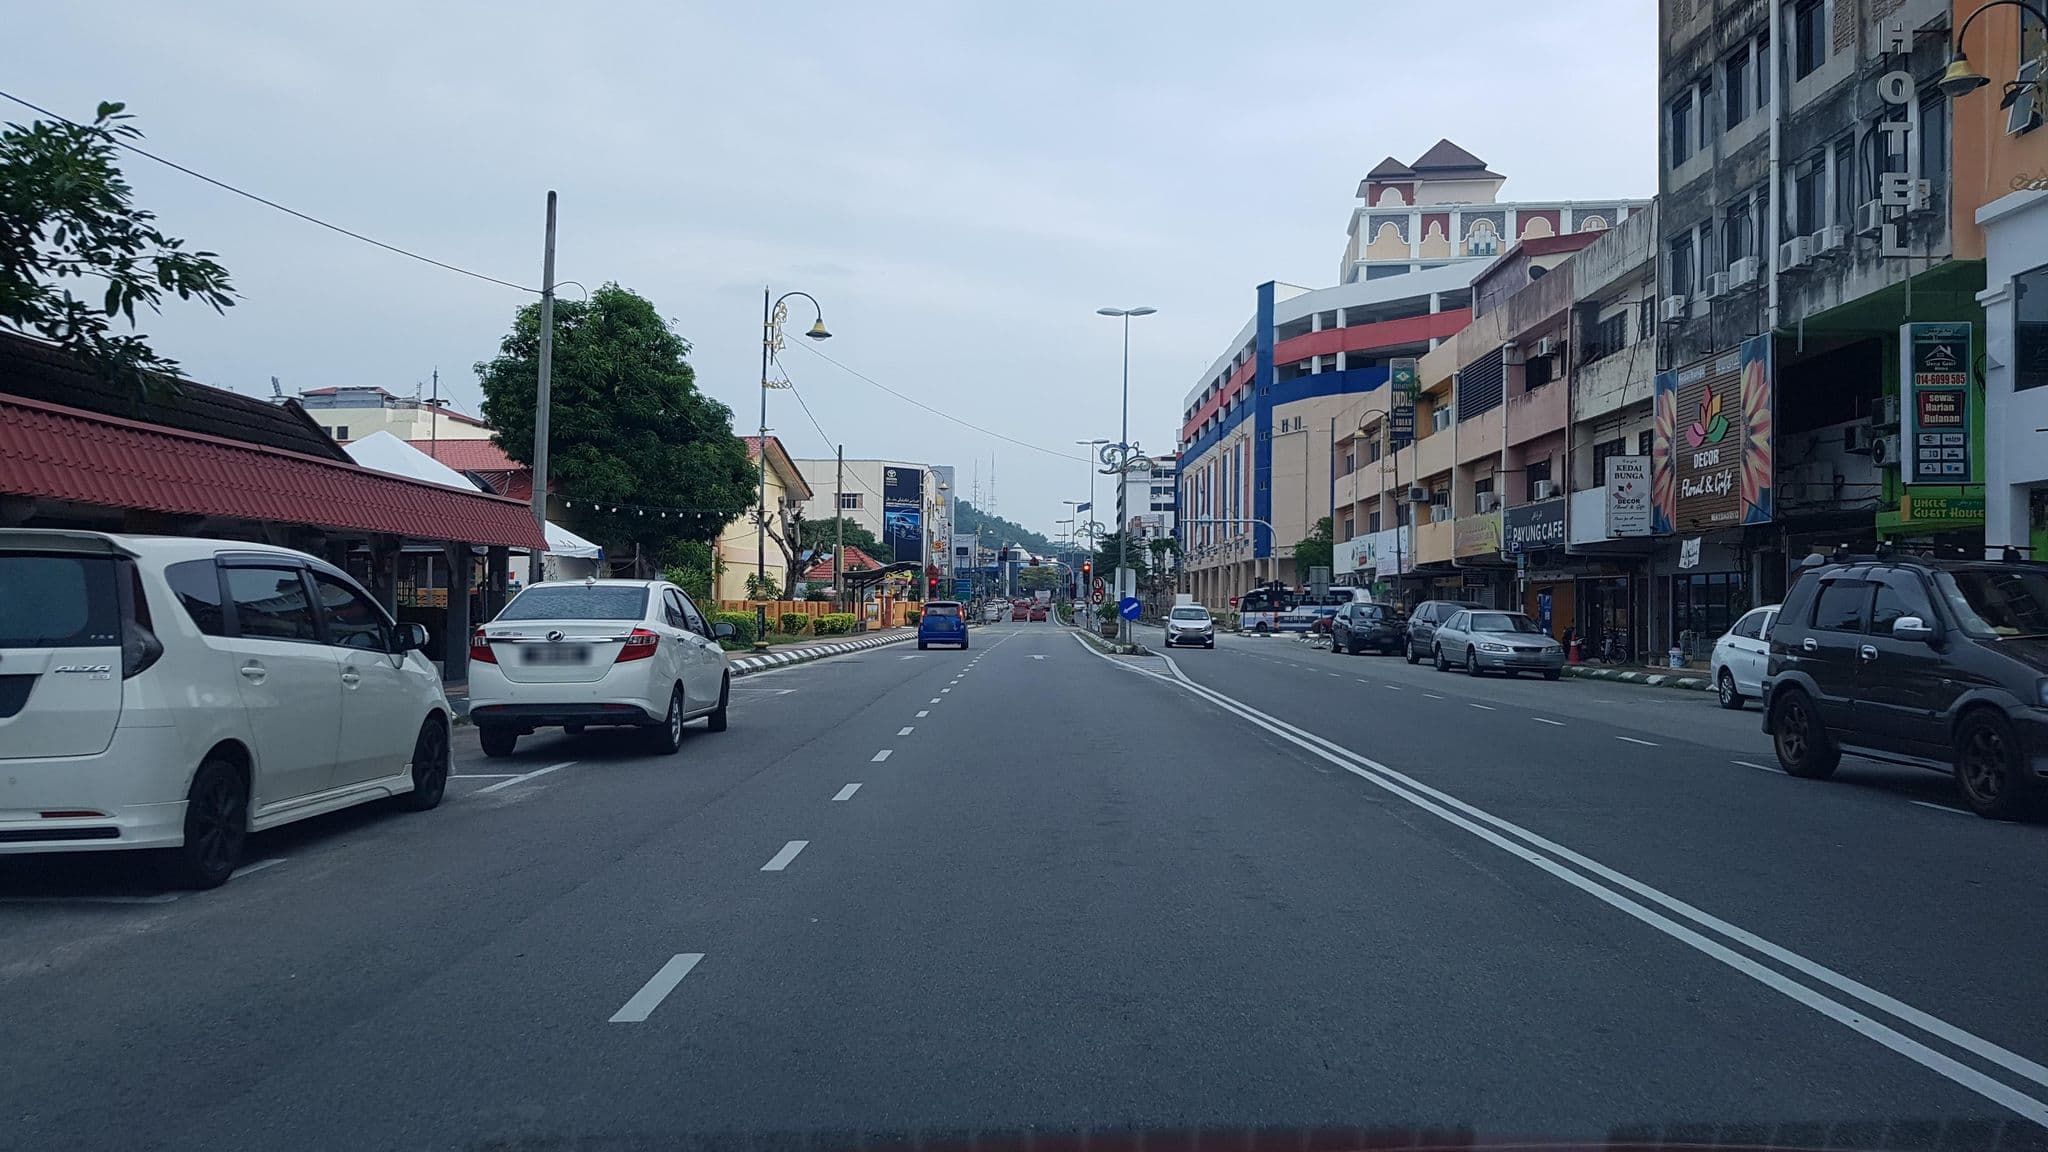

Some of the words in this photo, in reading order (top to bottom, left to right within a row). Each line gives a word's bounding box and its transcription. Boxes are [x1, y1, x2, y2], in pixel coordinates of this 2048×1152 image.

[1877, 18, 1915, 258] HOTEL
[1926, 403, 1955, 412] Harian
[1924, 414, 1960, 423] Bulanan
[1693, 449, 1720, 469] DECOR
[1616, 464, 1643, 472] KEDAI
[1614, 472, 1645, 480] BUNGA
[1948, 506, 1985, 518] HOUSE
[1512, 524, 1541, 542] PAYUNG
[1541, 520, 1563, 540] CAFE
[1511, 542, 1519, 552] P
[54, 664, 112, 673] ALZA
